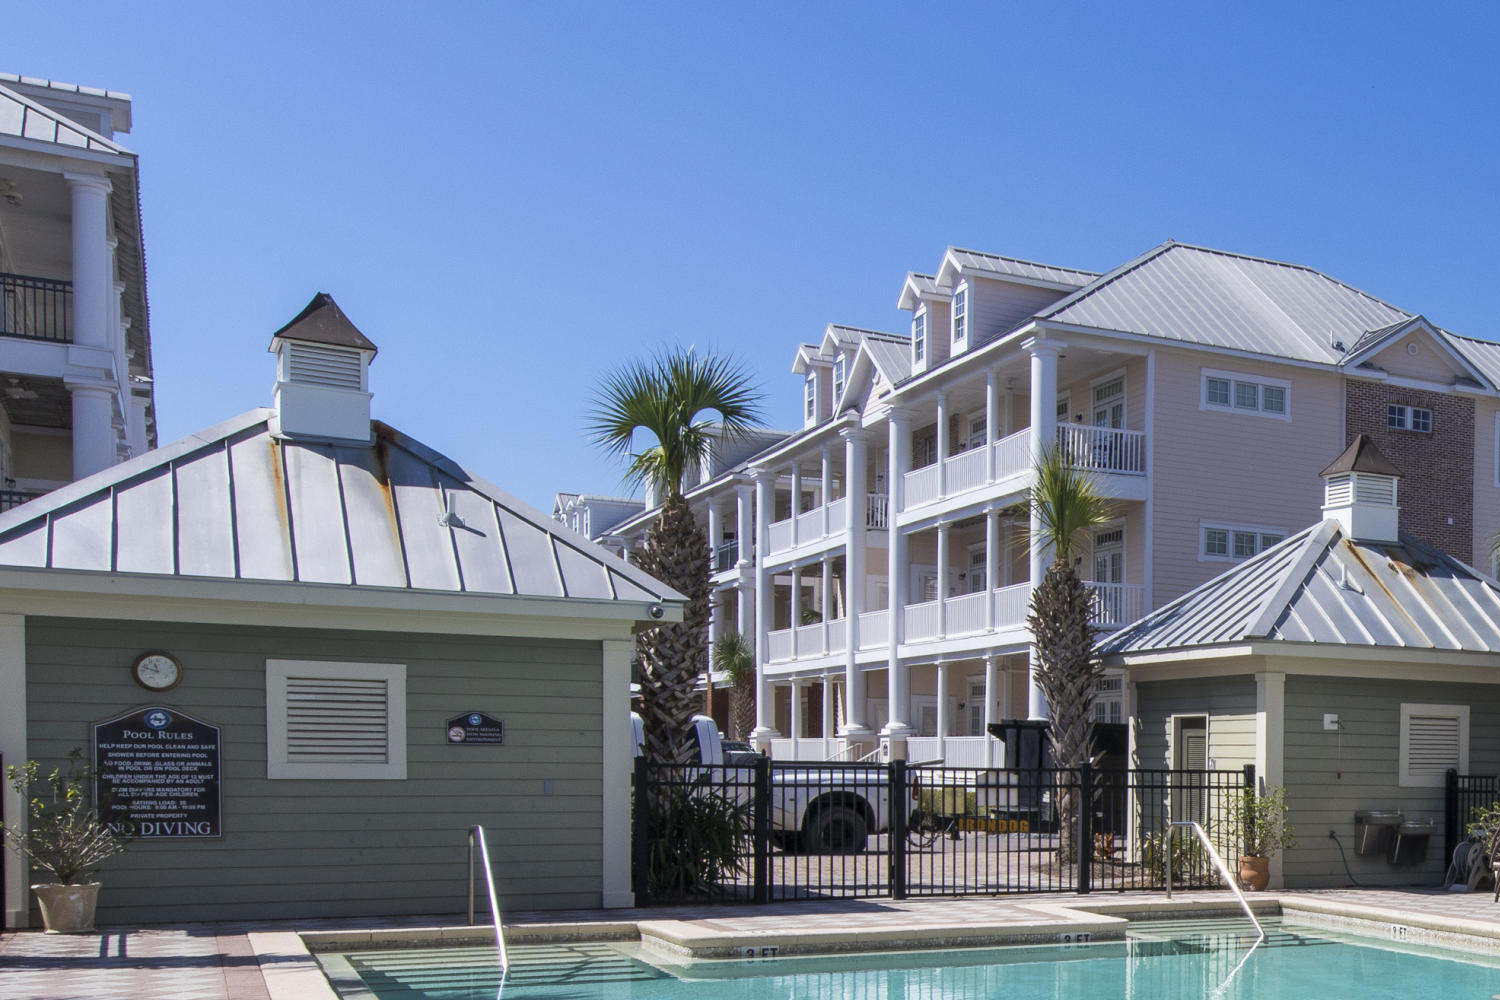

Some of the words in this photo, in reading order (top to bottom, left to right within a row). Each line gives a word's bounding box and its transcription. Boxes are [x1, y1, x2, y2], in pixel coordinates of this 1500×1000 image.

[123, 730, 154, 739] POOL
[158, 730, 193, 740] RULES
[141, 821, 211, 835] DIVING
[761, 947, 778, 958] FT
